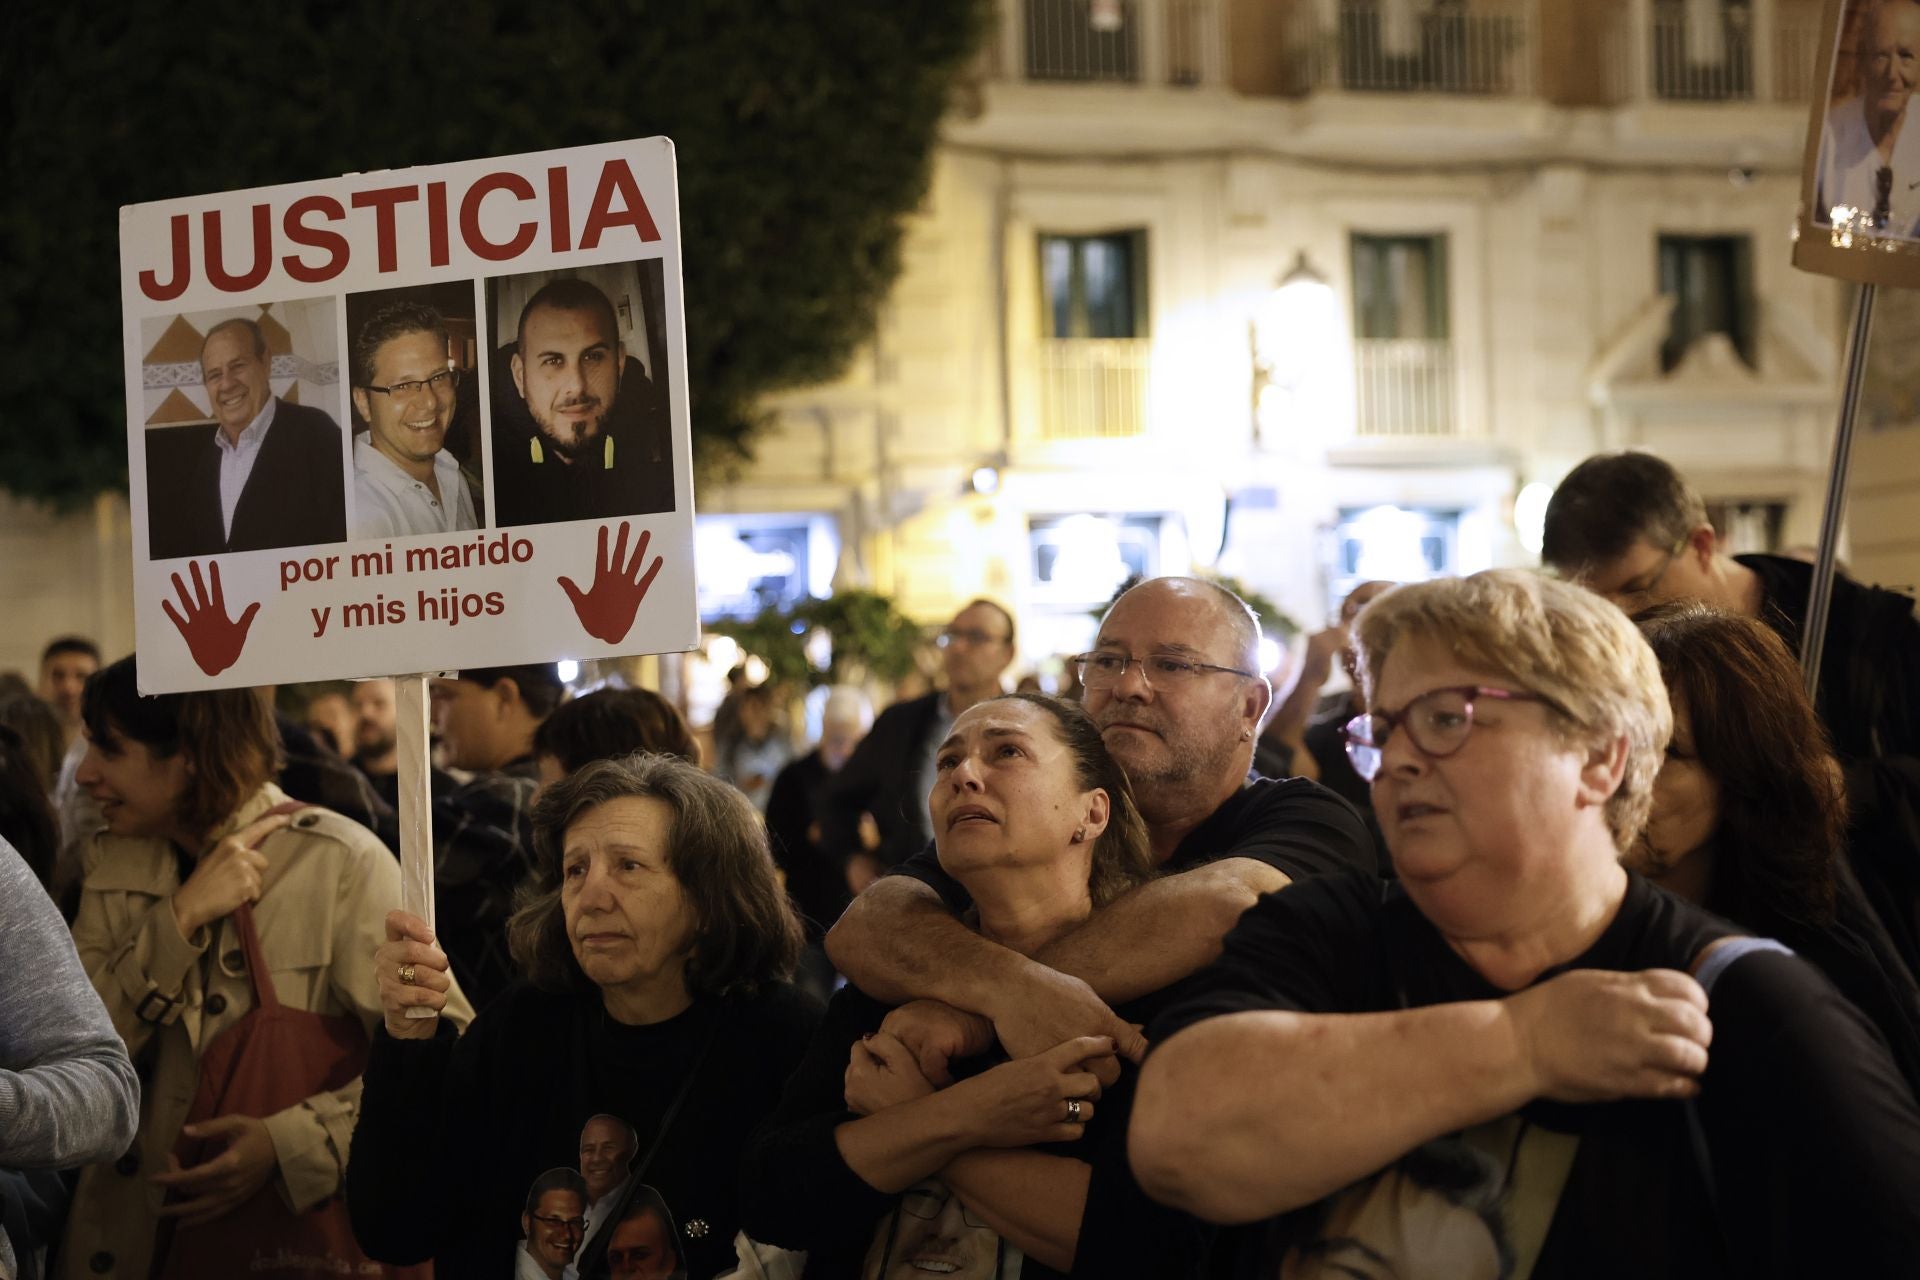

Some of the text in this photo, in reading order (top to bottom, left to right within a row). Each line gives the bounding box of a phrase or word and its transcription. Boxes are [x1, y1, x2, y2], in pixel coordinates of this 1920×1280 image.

[138, 158, 662, 302] JUSTICIA
[280, 533, 534, 591] por mi marido
[311, 587, 505, 638] y mis hijos
